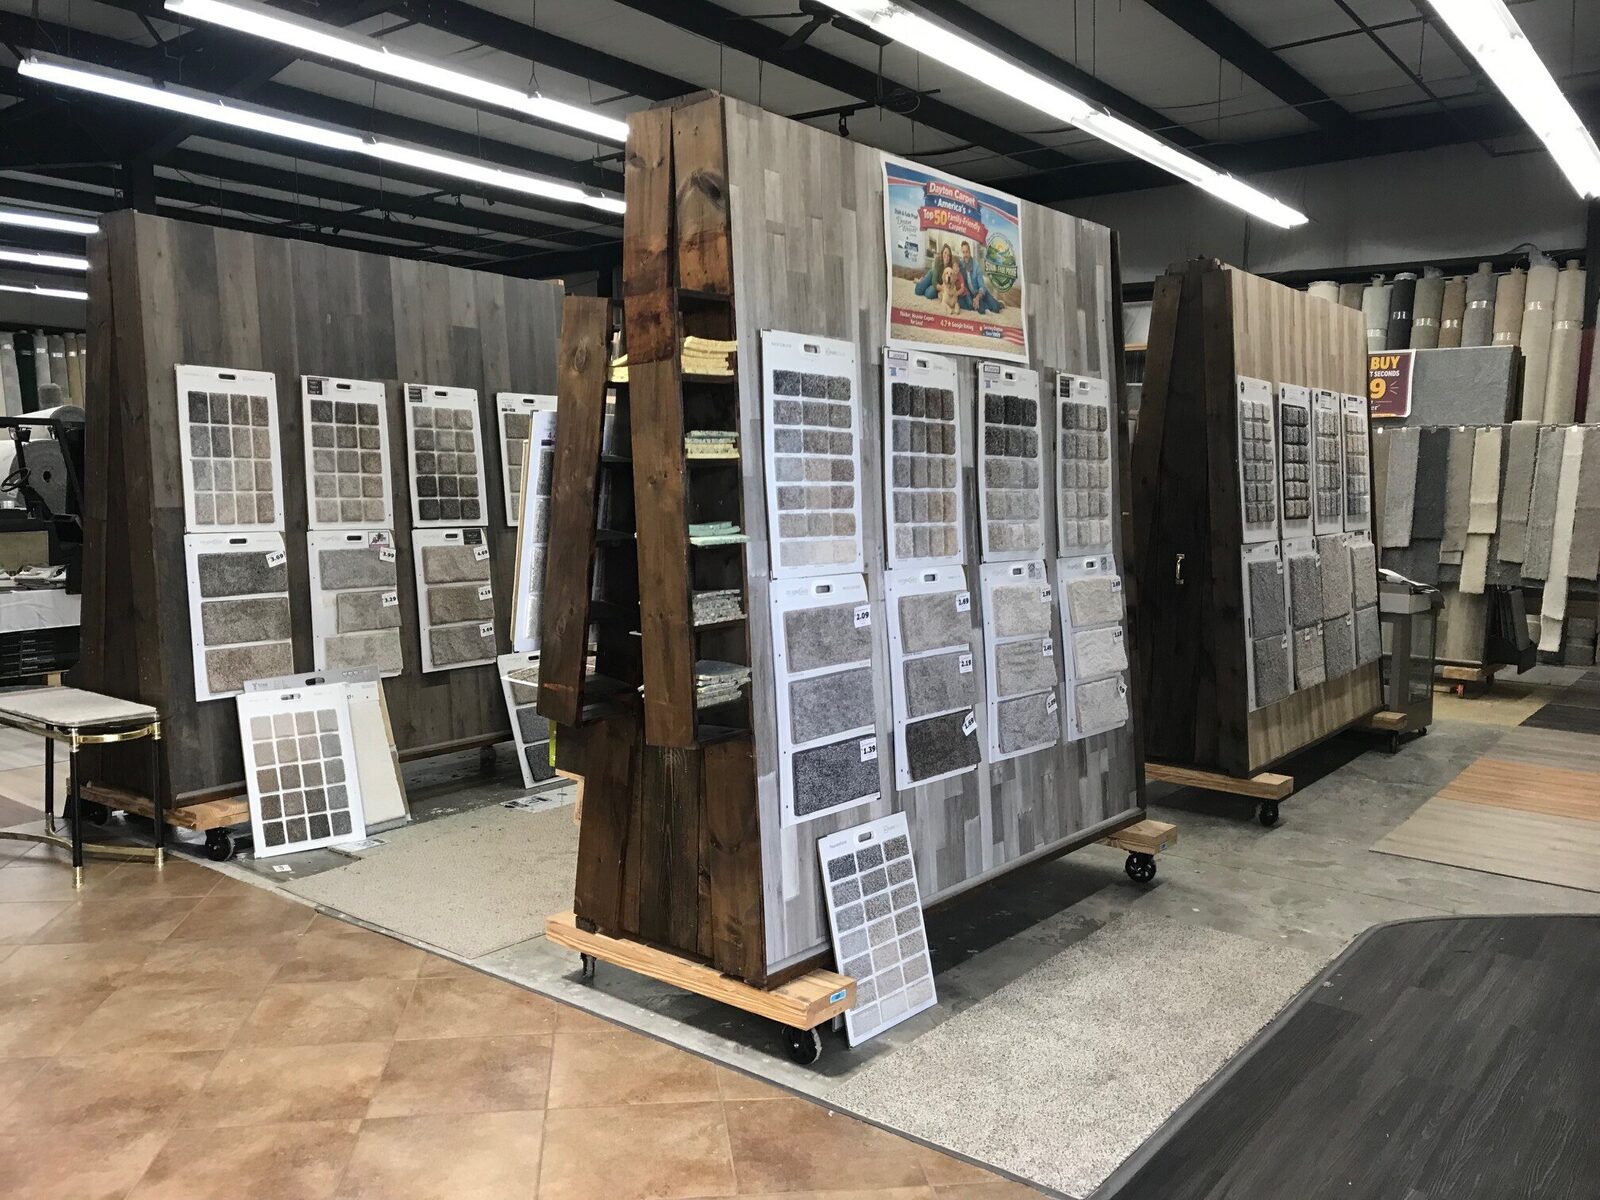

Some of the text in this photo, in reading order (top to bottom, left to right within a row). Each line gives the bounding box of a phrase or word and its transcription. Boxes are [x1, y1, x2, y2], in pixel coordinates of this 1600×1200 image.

[930, 183, 976, 206] Dayton Carpet
[937, 198, 966, 214] America's
[923, 209, 934, 220] Top
[934, 209, 947, 225] 50
[1370, 356, 1400, 370] BUY
[857, 612, 869, 620] 2.09
[864, 745, 876, 754] 1.39
